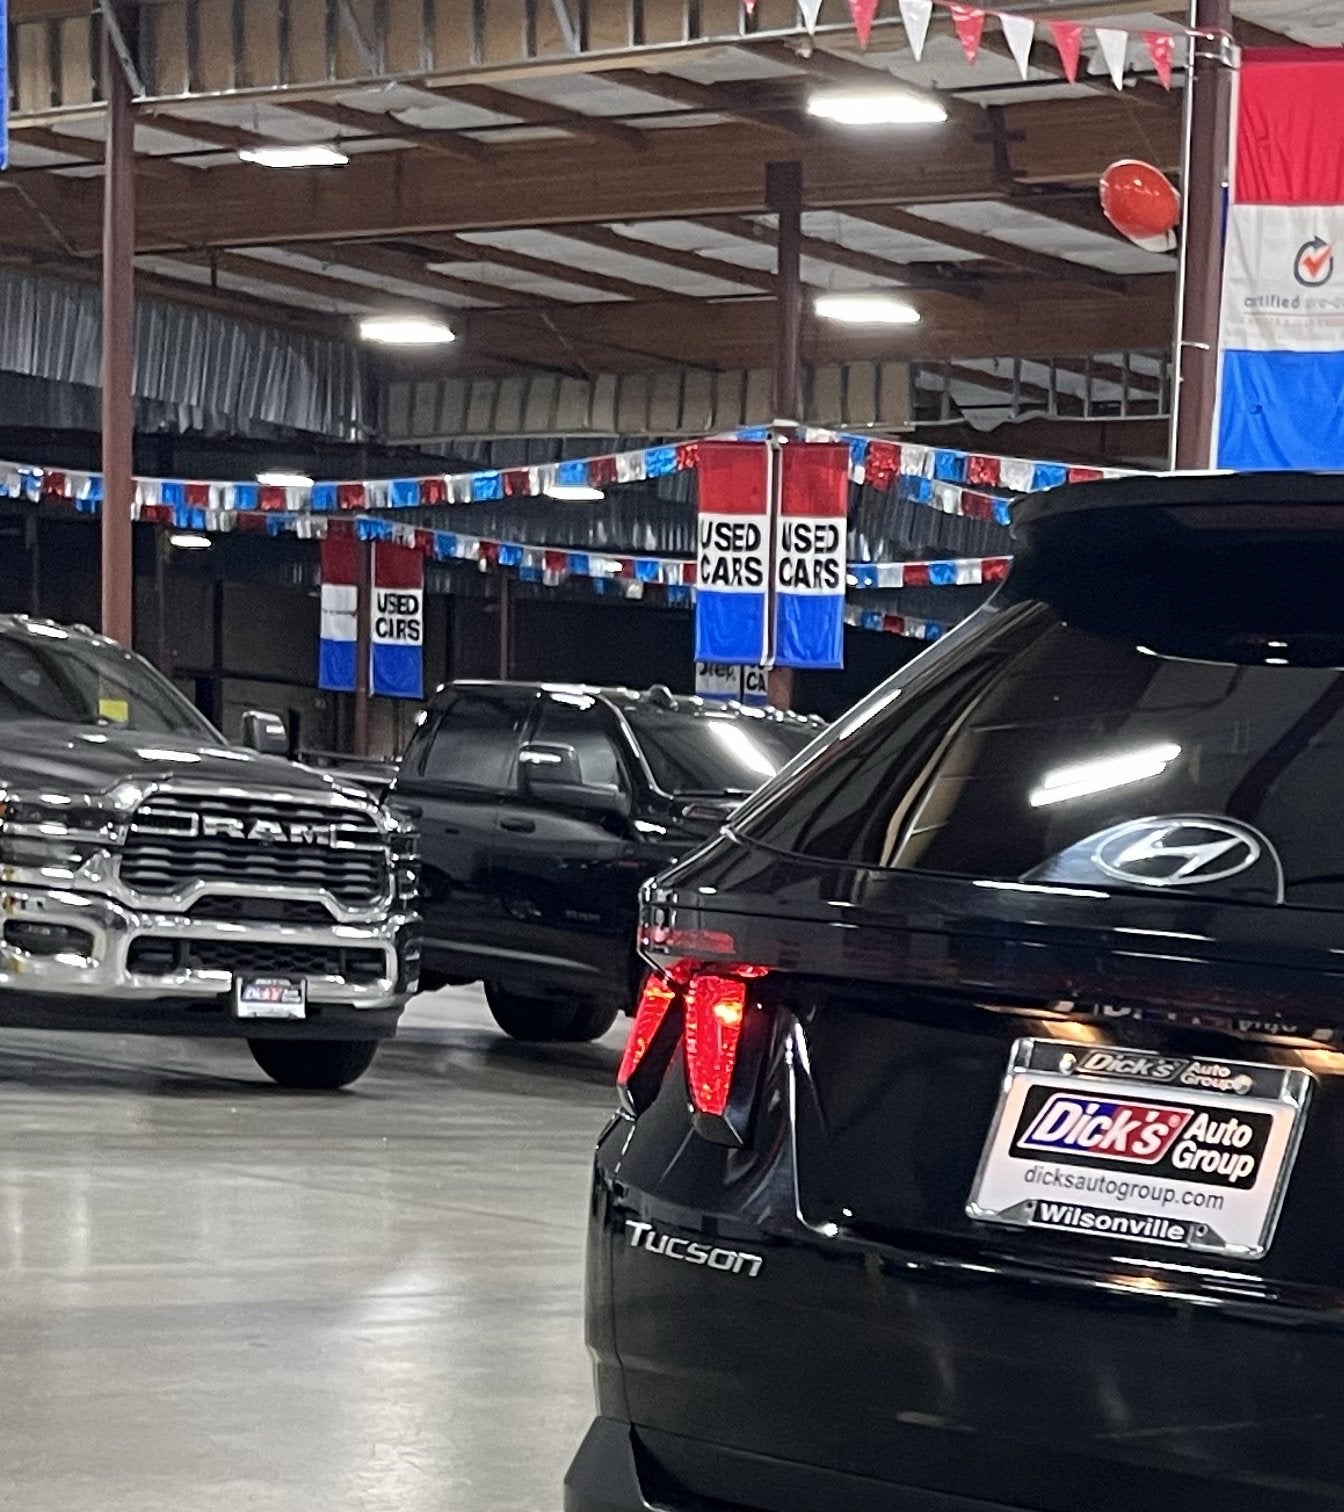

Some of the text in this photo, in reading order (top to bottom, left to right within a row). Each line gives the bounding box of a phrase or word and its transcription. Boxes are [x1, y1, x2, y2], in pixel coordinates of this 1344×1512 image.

[701, 521, 761, 552] USED
[782, 523, 839, 553] USED
[701, 554, 763, 587] CARS
[779, 557, 839, 588] CARS
[377, 593, 419, 615] USED
[746, 672, 766, 691] CA
[202, 815, 333, 845] RAM
[1084, 1053, 1231, 1078] Dick's Auto
[1031, 1101, 1253, 1156] Dick's Auto
[1171, 1138, 1256, 1183] Group
[1024, 1164, 1225, 1210] dicksautogroup.com
[1039, 1202, 1185, 1241] Wilsonville
